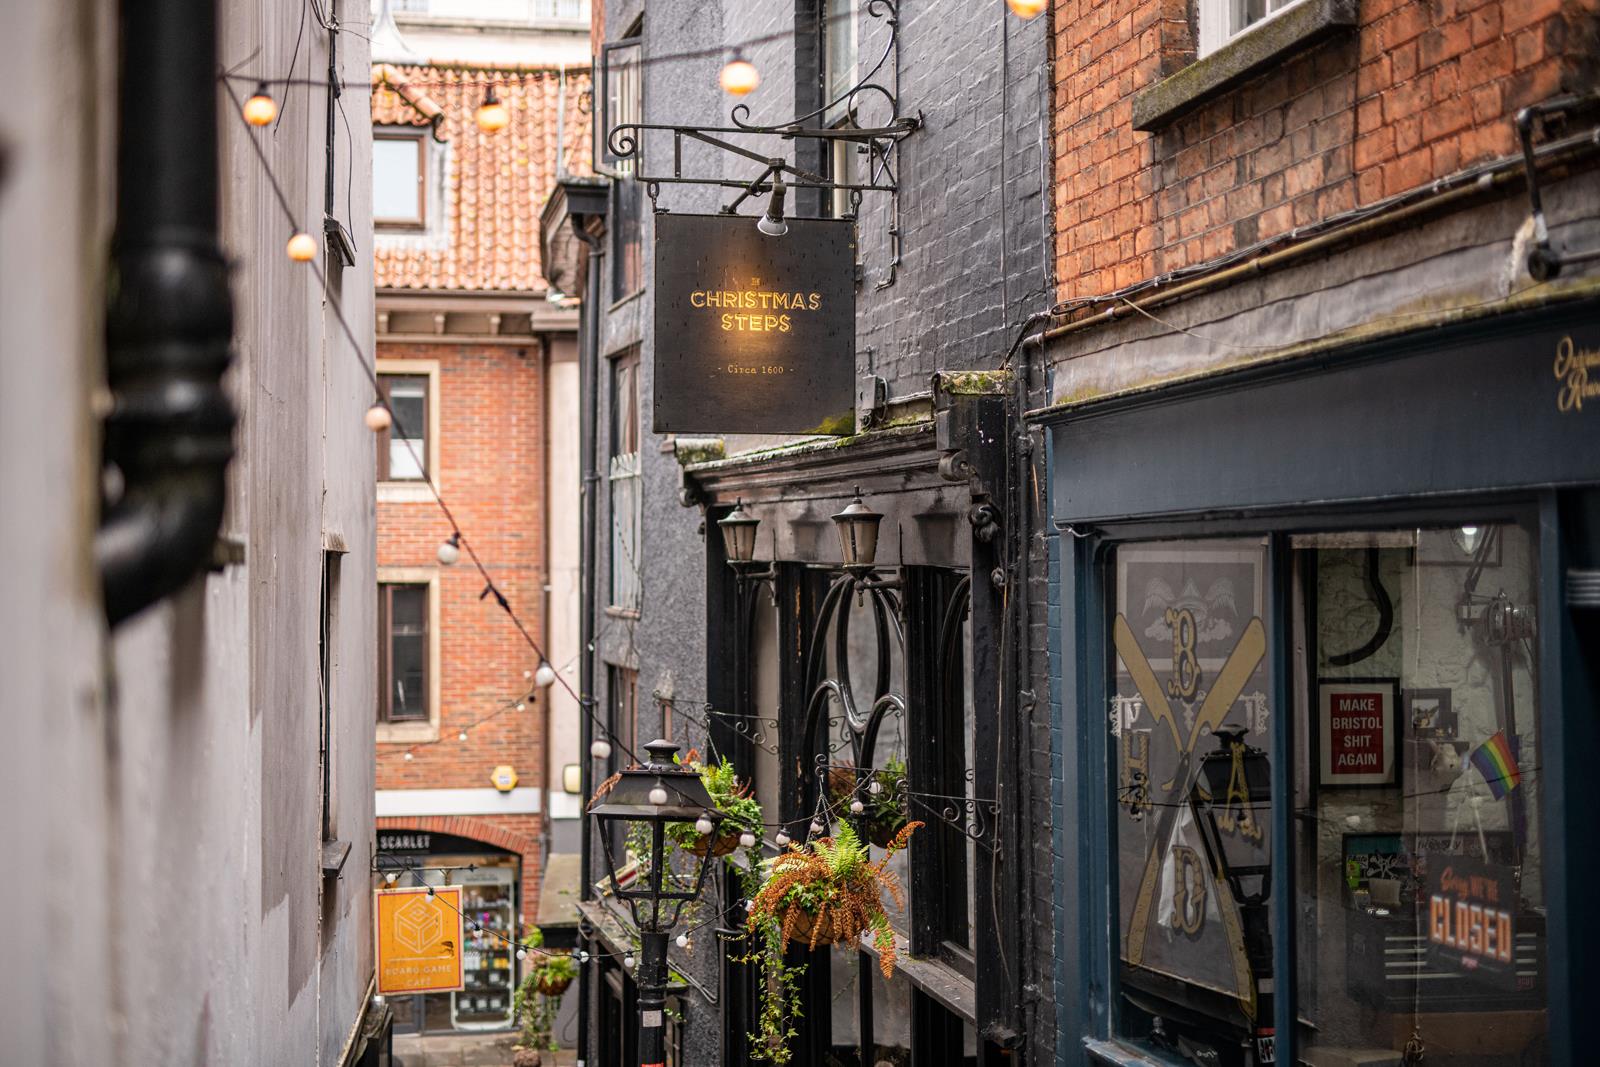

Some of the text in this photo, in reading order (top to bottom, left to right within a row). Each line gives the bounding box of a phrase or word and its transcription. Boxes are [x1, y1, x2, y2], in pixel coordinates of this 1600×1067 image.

[690, 290, 821, 311] CHRISTMAS
[721, 313, 792, 332] STEPS
[727, 364, 784, 375] Circa 1600
[1339, 699, 1375, 711] MAKE
[1332, 717, 1383, 729] BRISTOL
[1343, 735, 1372, 748] SHIT
[1338, 753, 1377, 765] AGAIN
[380, 835, 430, 849] SCARLET
[1430, 895, 1512, 963] CLOSED
[423, 964, 452, 973] GAME
